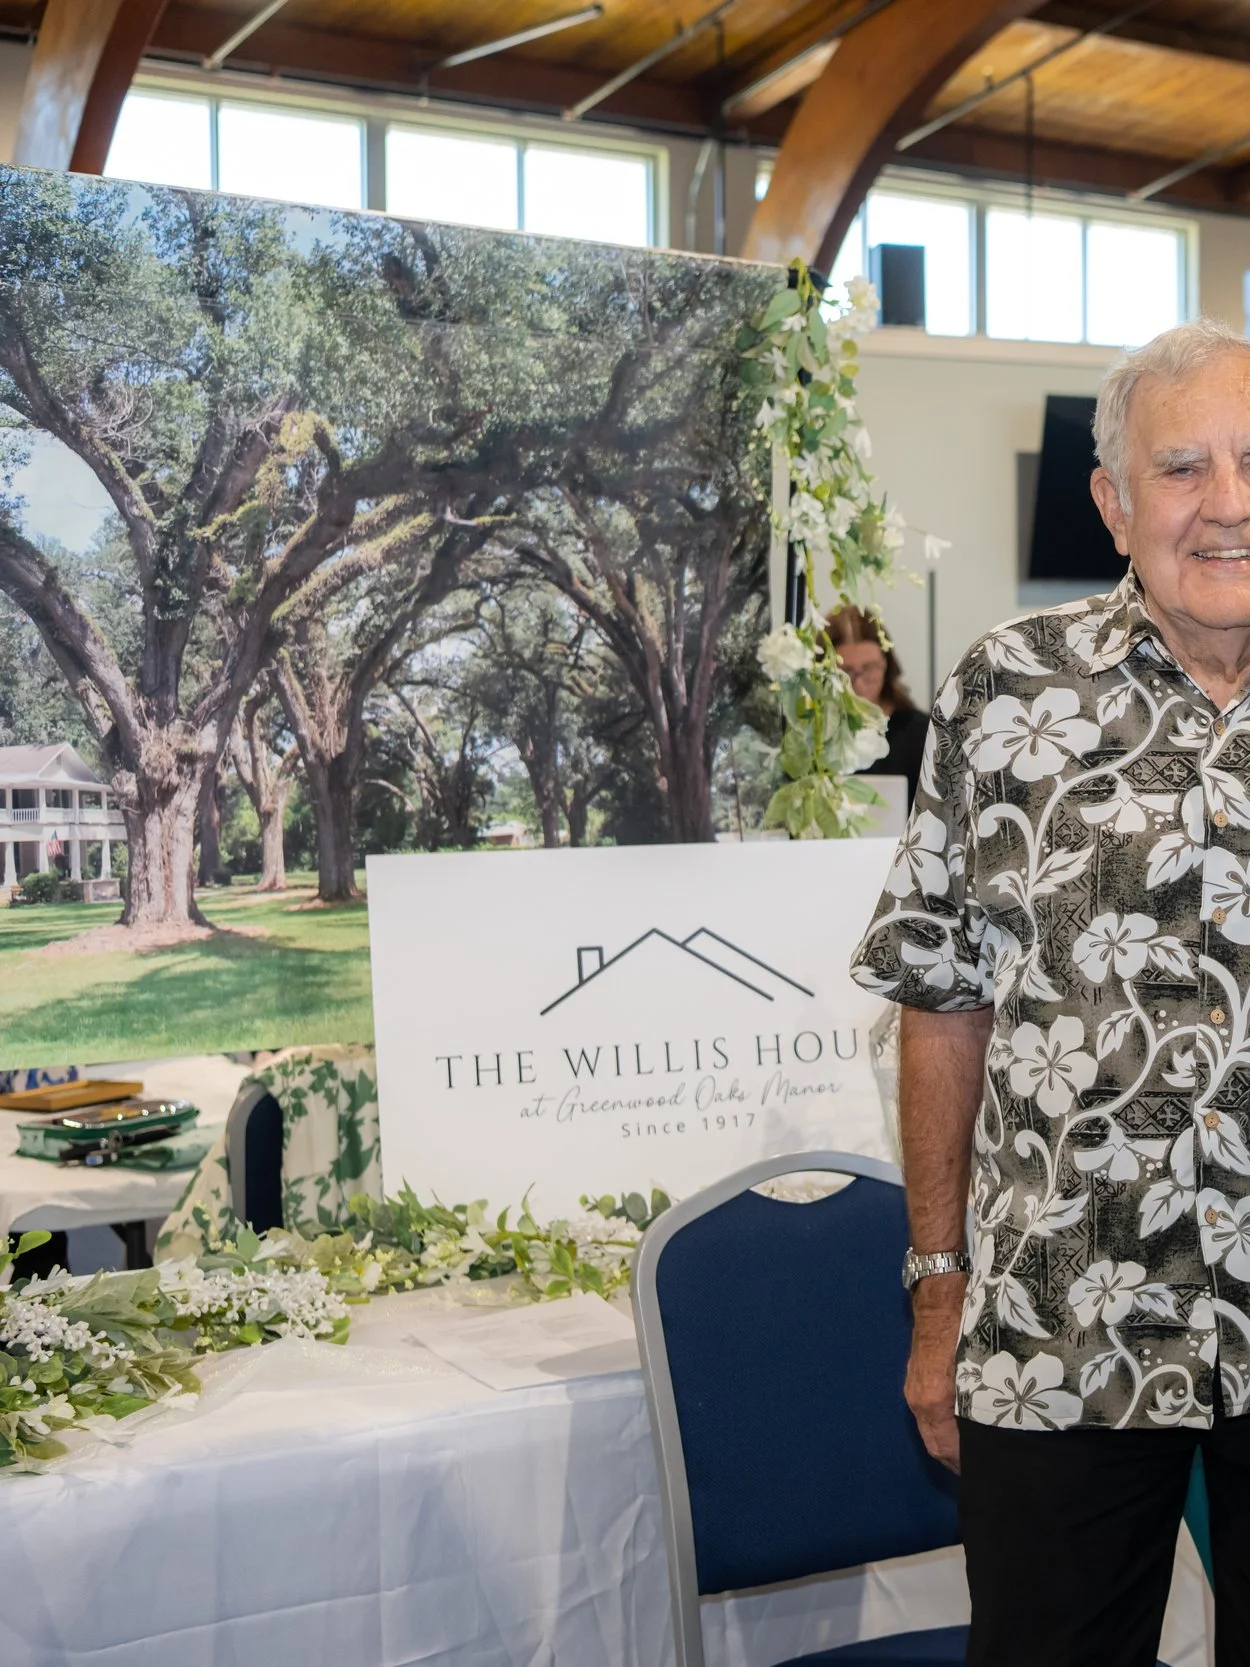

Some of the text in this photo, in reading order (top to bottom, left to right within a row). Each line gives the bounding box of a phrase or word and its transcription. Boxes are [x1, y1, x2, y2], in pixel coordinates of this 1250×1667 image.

[435, 1027, 884, 1089] THE WILLIS HOU
[520, 1070, 844, 1123] at Greenwood Oaks Manor
[621, 1112, 756, 1138] Since 1917
